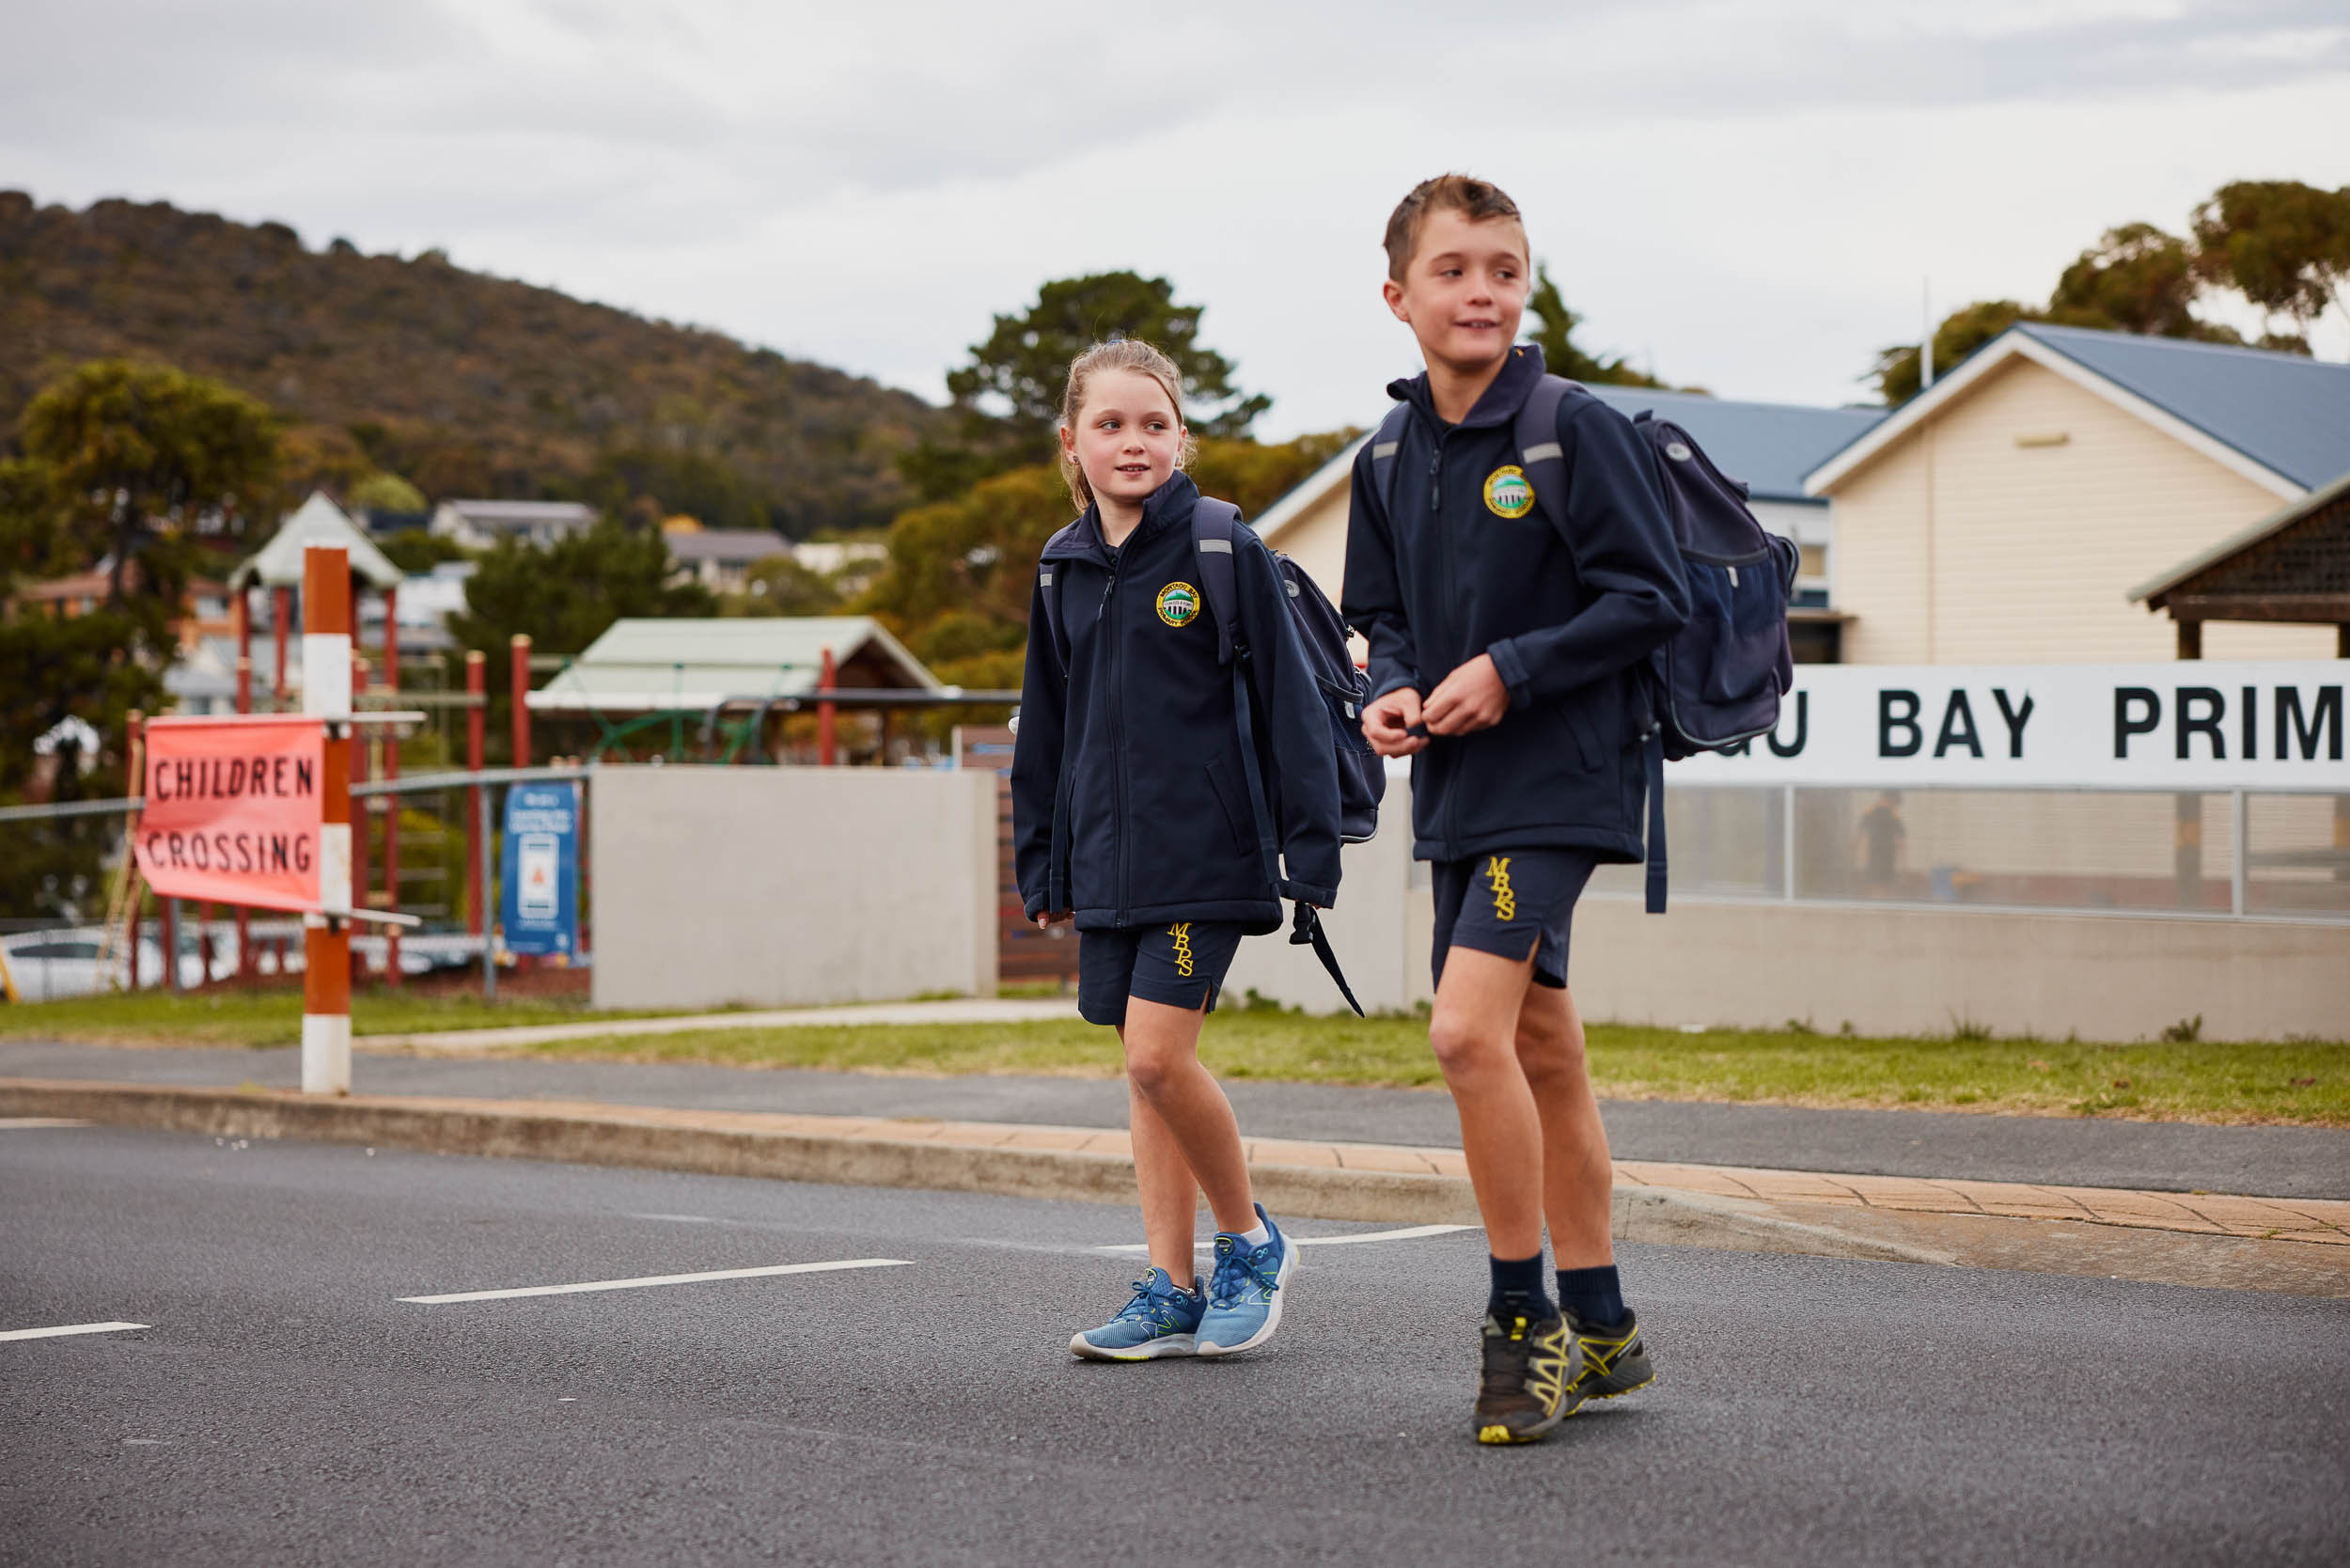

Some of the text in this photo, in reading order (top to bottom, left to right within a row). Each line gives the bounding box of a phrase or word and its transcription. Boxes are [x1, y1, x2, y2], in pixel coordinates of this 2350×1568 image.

[1160, 584, 1198, 598] MONTAGU BAY
[1877, 687, 2035, 759] BAY
[2113, 686, 2343, 760] PRIM
[155, 757, 313, 801] CHILDREN
[147, 831, 310, 874] CROSSING
[1484, 855, 1516, 921] MBPS
[1167, 921, 1194, 977] MBPS
